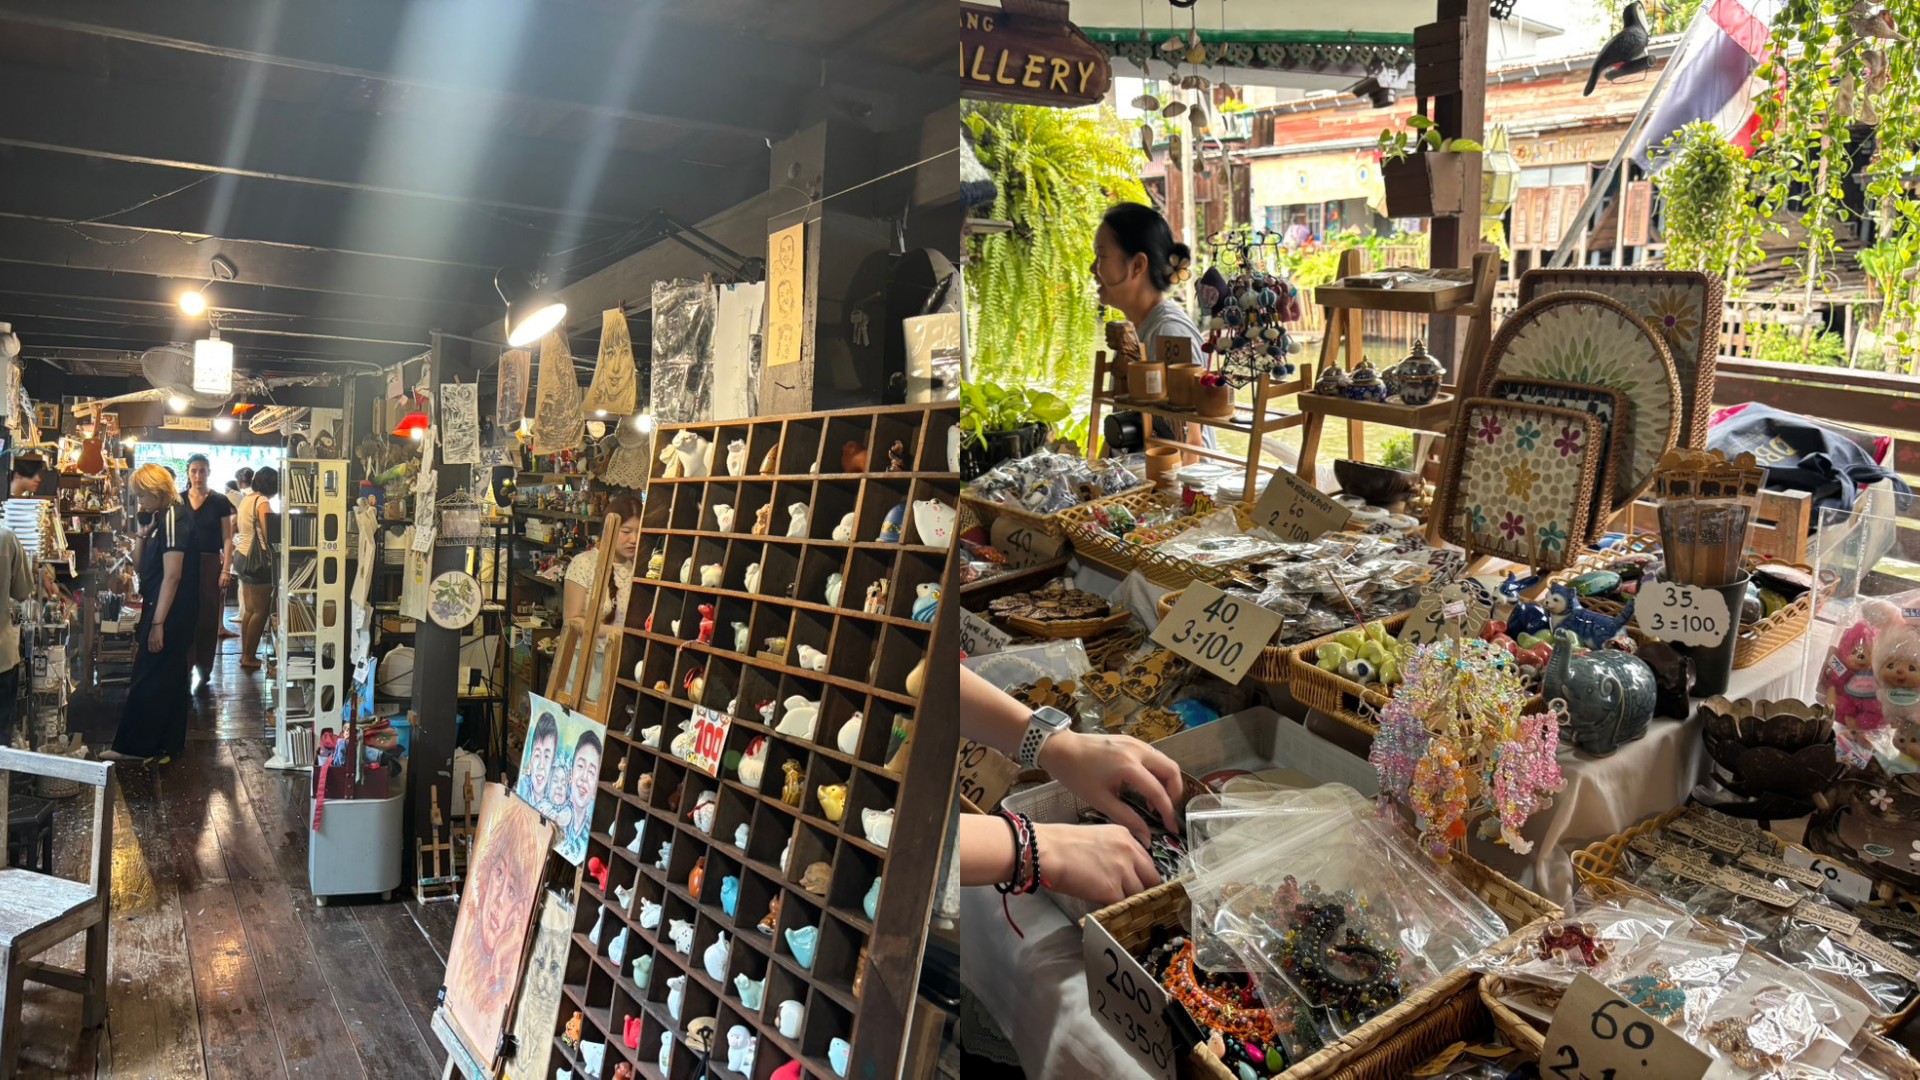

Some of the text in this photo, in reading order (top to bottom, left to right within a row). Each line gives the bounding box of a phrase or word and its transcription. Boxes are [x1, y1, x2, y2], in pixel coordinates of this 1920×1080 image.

[960, 12, 994, 32] NG
[1007, 528, 1032, 552] 40
[694, 719, 724, 762] 100
[1692, 827, 1740, 848] Thailand
[1765, 863, 1820, 883] Thailand
[1739, 882, 1794, 904] Thailand
[1794, 908, 1852, 928] Thailand
[1858, 941, 1919, 974] Thailand
